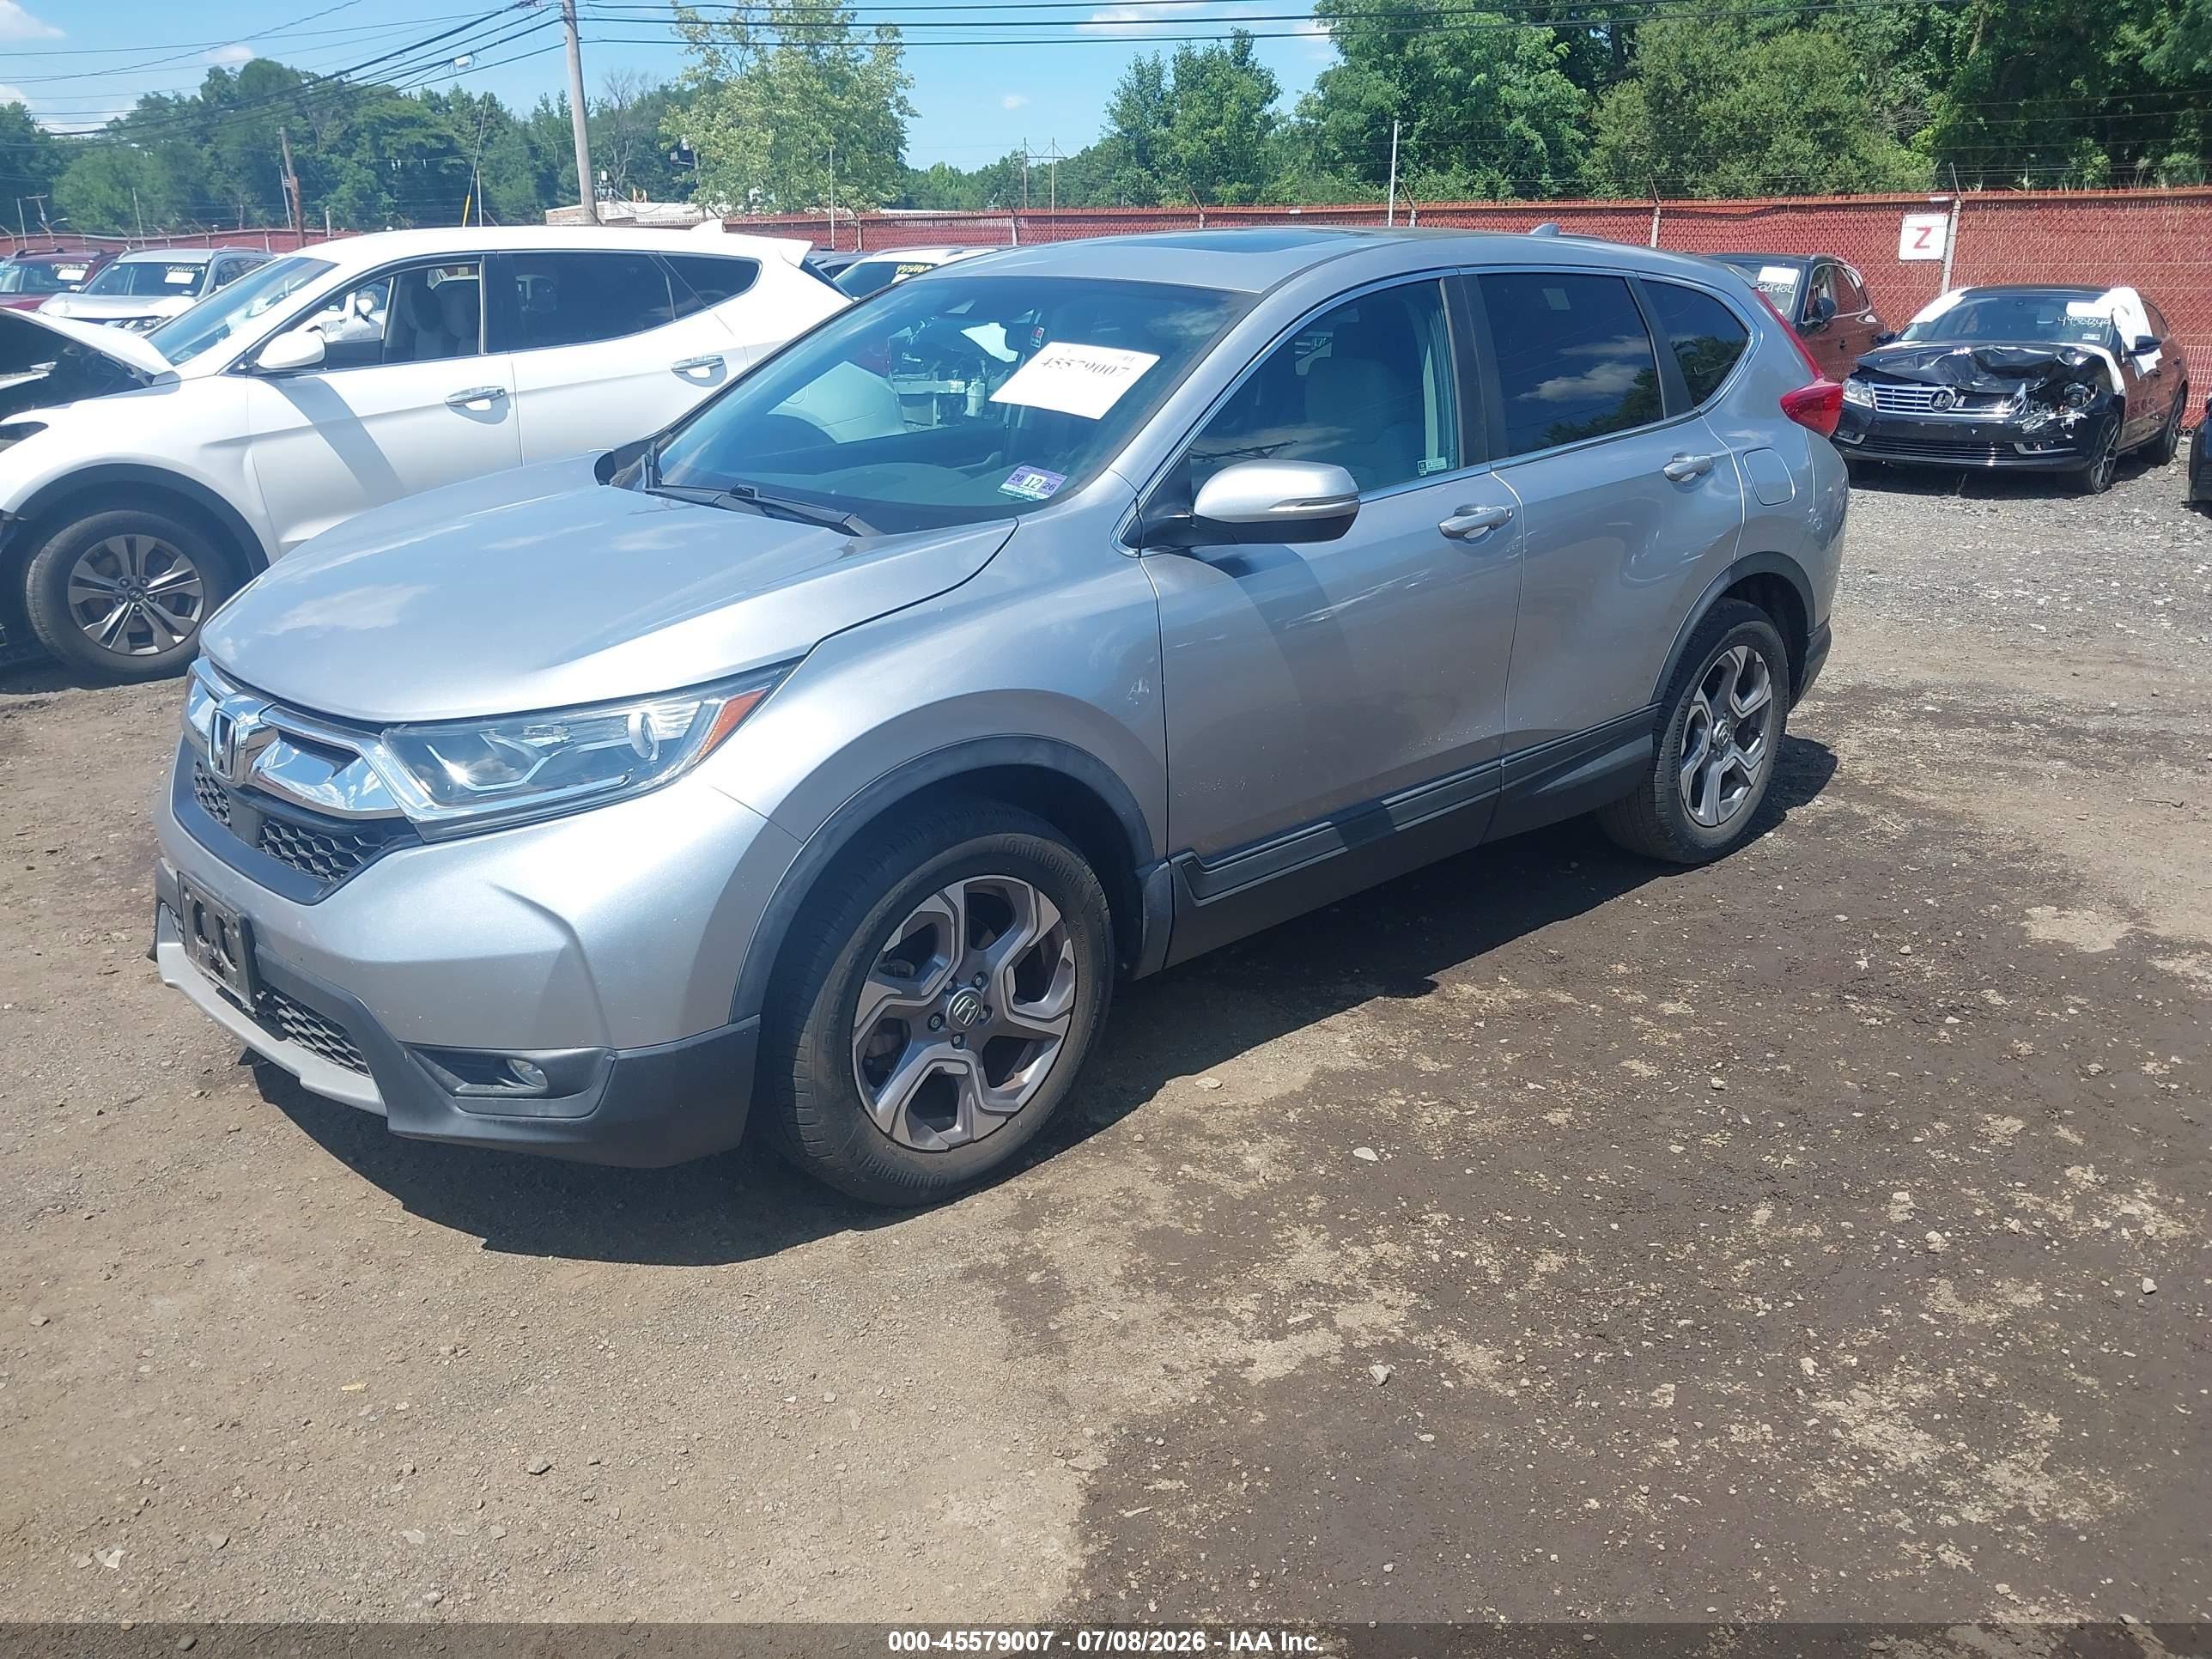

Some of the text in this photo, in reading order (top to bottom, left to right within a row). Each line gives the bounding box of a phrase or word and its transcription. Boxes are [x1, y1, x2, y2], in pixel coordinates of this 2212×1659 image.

[1913, 226, 1932, 249] Z
[1041, 357, 1131, 377] 45579007
[1012, 473, 1025, 483] 20
[1024, 477, 1042, 489] 12
[1042, 482, 1057, 491] 26
